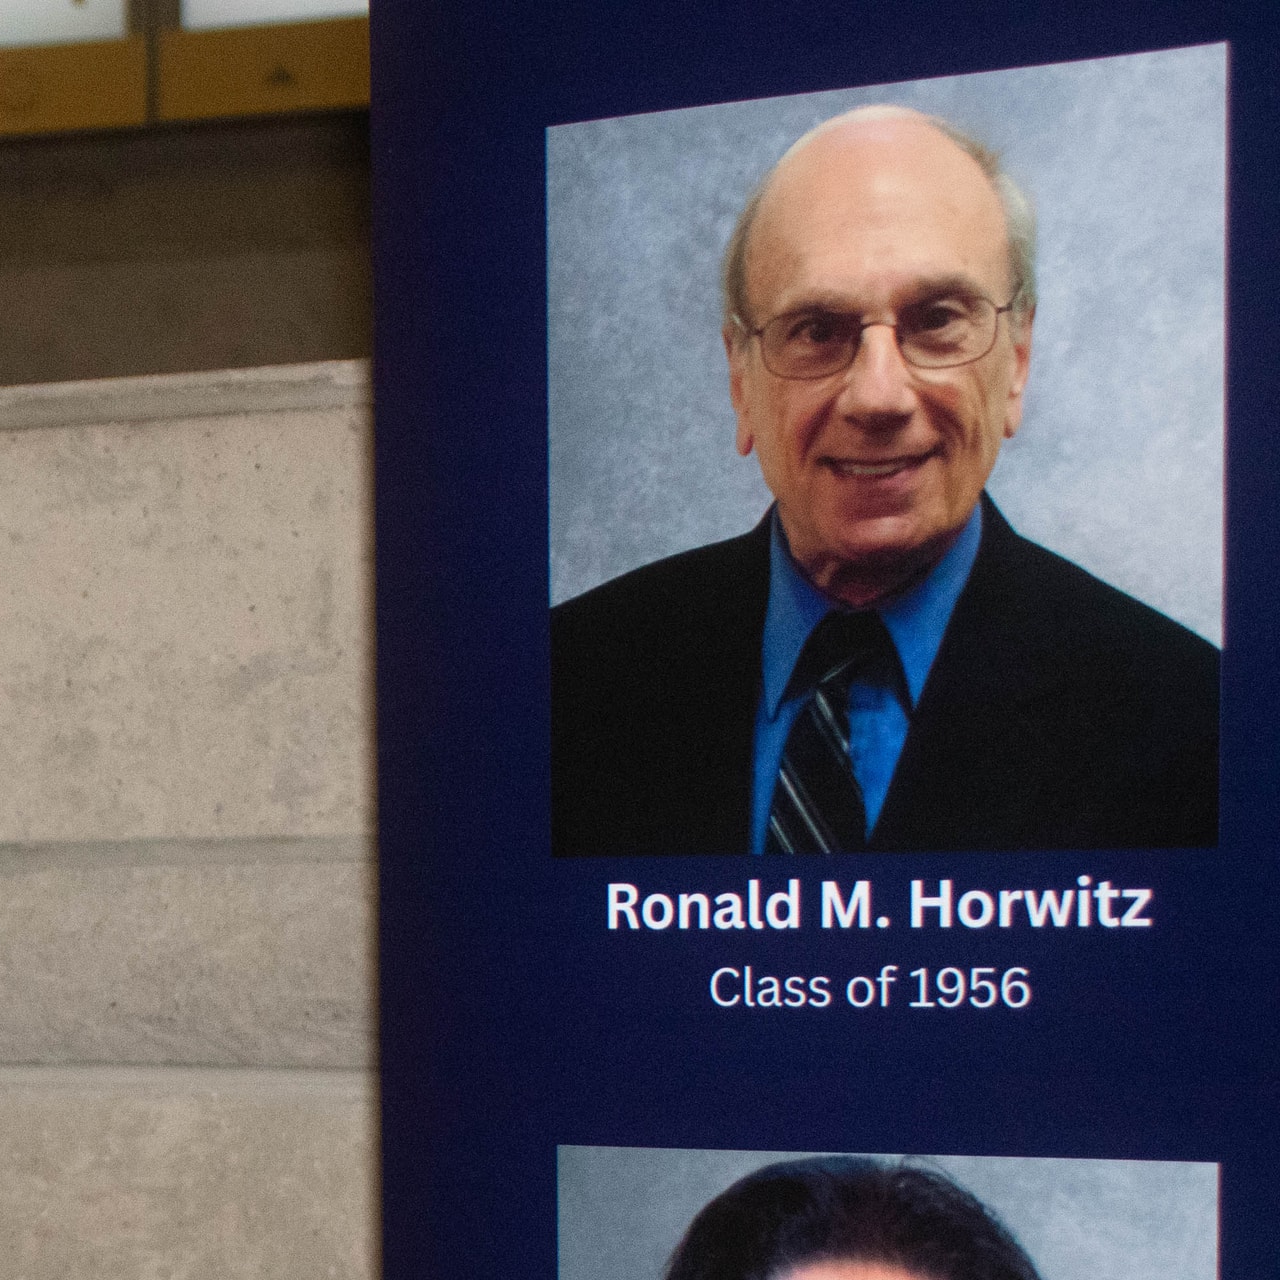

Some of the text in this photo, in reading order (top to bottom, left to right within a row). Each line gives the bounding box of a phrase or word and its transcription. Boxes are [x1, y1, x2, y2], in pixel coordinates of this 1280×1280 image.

[606, 874, 1153, 930] Ronald M. Horwitz
[710, 964, 1031, 1009] Class of 1956
